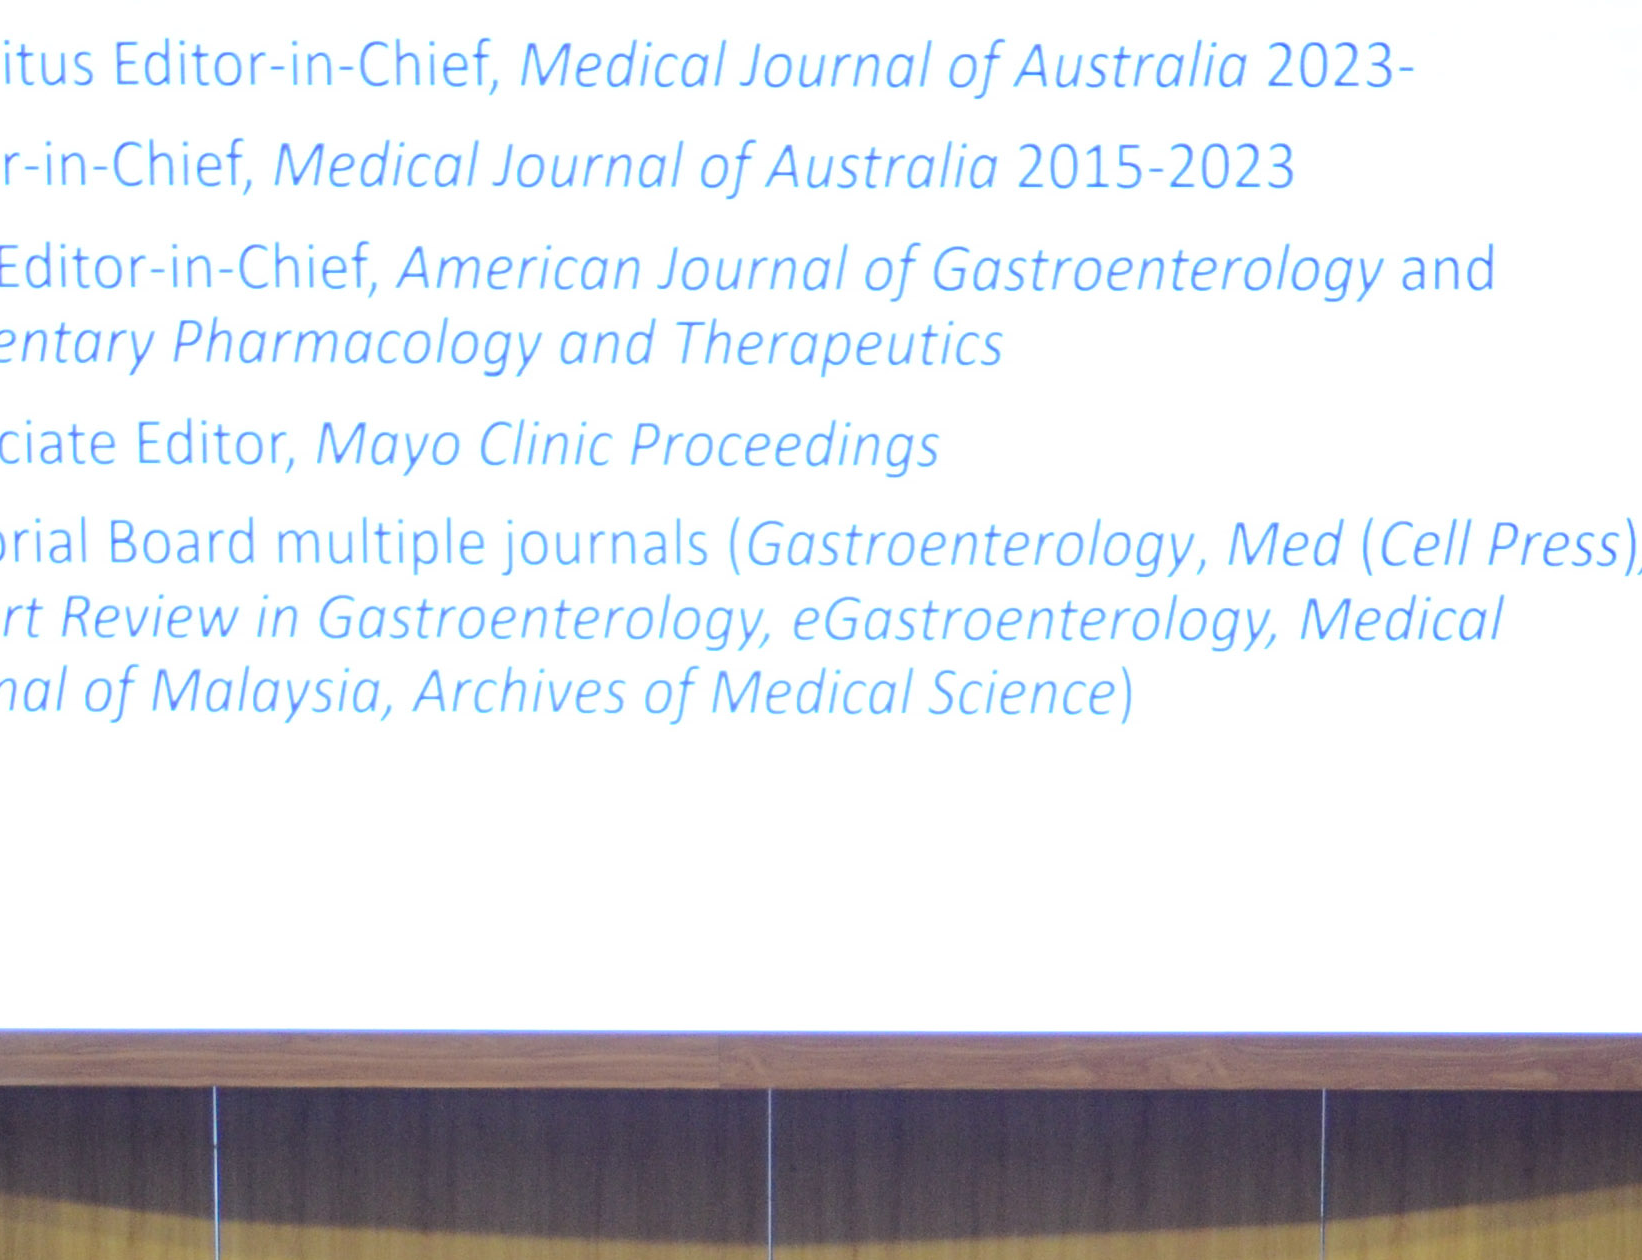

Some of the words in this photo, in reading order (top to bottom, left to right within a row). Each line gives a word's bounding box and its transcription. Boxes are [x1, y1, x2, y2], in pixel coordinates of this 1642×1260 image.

[116, 38, 498, 96] Editor-in-Chief,
[521, 40, 726, 88] Medical
[739, 40, 932, 88] Journal
[949, 39, 1005, 99] of
[1014, 40, 1247, 89] Australia
[1268, 42, 1414, 88] 2023-
[274, 140, 479, 188] Medical
[492, 140, 684, 188] Journal
[701, 139, 755, 200] of
[765, 141, 997, 189] Australia
[1018, 143, 1293, 189] 2015-2023
[395, 245, 640, 290] American
[657, 243, 848, 291] Journal
[865, 242, 921, 302] of
[933, 243, 1384, 302] Gastroenterology
[1402, 243, 1494, 291] and
[173, 316, 542, 377] Pharmacology
[560, 318, 656, 365] and
[676, 318, 1003, 378] Therapeutics
[138, 418, 294, 473] Editor,
[317, 422, 460, 476] Mayo
[481, 419, 613, 466] Clinic
[631, 420, 939, 478] Proceedings
[111, 516, 254, 564] Board
[278, 517, 485, 576] multiple
[501, 518, 707, 576] journals
[729, 517, 1206, 578] (Gastroenterology,
[1229, 518, 1344, 567] Med
[1363, 517, 1472, 576] (Cell
[61, 594, 239, 638] Review
[257, 594, 297, 637] in
[319, 594, 770, 651] Gastroenterology,
[793, 594, 1276, 652] eGastroenterology,
[1301, 594, 1504, 641] Medical
[85, 664, 139, 723] of
[152, 666, 392, 723] Malaysia,
[412, 666, 626, 714] Archives
[645, 666, 700, 725] of
[712, 667, 913, 715] Medical
[928, 666, 1131, 724] Science)
